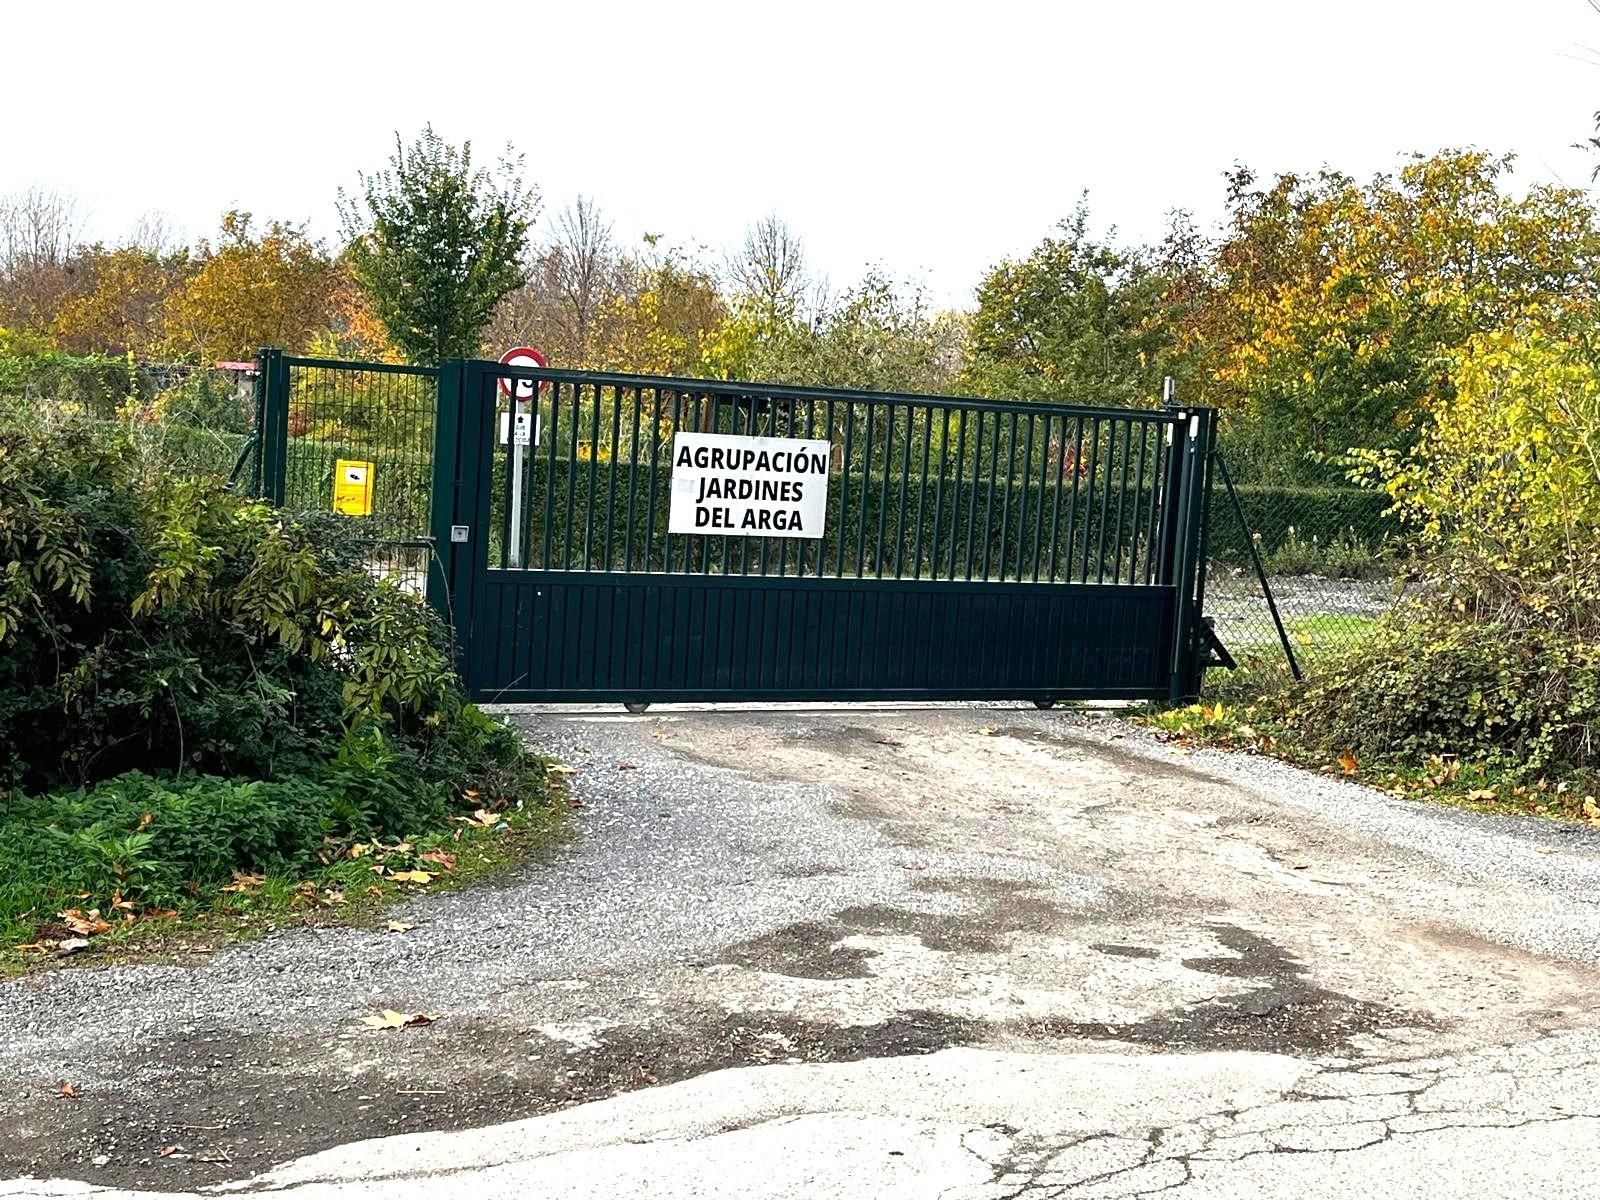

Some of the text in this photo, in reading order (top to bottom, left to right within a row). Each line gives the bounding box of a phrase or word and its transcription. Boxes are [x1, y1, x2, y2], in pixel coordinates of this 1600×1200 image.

[676, 445, 827, 475] AGRUPACIÓN
[695, 476, 804, 504] JARDINES
[695, 507, 803, 531] DEL ARGA
